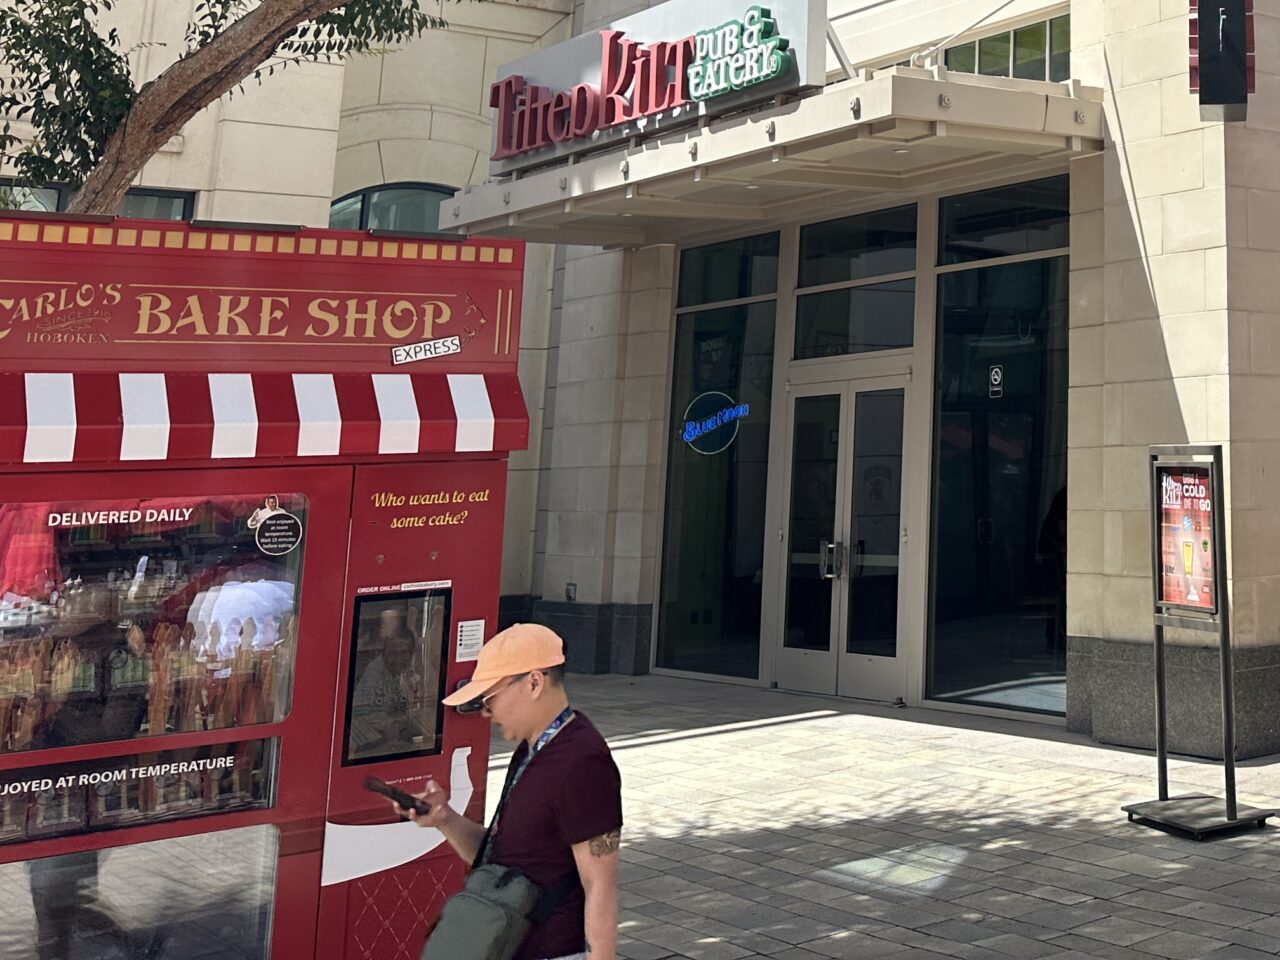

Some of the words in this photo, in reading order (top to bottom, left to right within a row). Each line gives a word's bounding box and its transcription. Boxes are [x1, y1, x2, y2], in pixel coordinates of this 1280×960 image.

[695, 24, 739, 65] PUB
[743, 9, 761, 48] &
[0, 283, 122, 339] ARLO'S
[134, 292, 290, 338] BAKE
[305, 297, 452, 339] SHOP
[26, 331, 109, 344] HOBOKEN
[393, 339, 460, 364] EXPRESS
[371, 491, 406, 507] Who
[409, 491, 449, 505] wants
[452, 490, 465, 503] to
[468, 489, 490, 502] eat
[1183, 484, 1206, 498] COLD
[1199, 499, 1211, 512] GO
[48, 509, 142, 527] DELIVERED
[145, 507, 194, 523] DAILY
[390, 516, 426, 528] some
[428, 510, 468, 526] cake?
[0, 779, 52, 795] JOYED
[55, 775, 76, 789] AT
[78, 769, 126, 786] ROOM
[130, 756, 234, 779] TEMPERATURE
